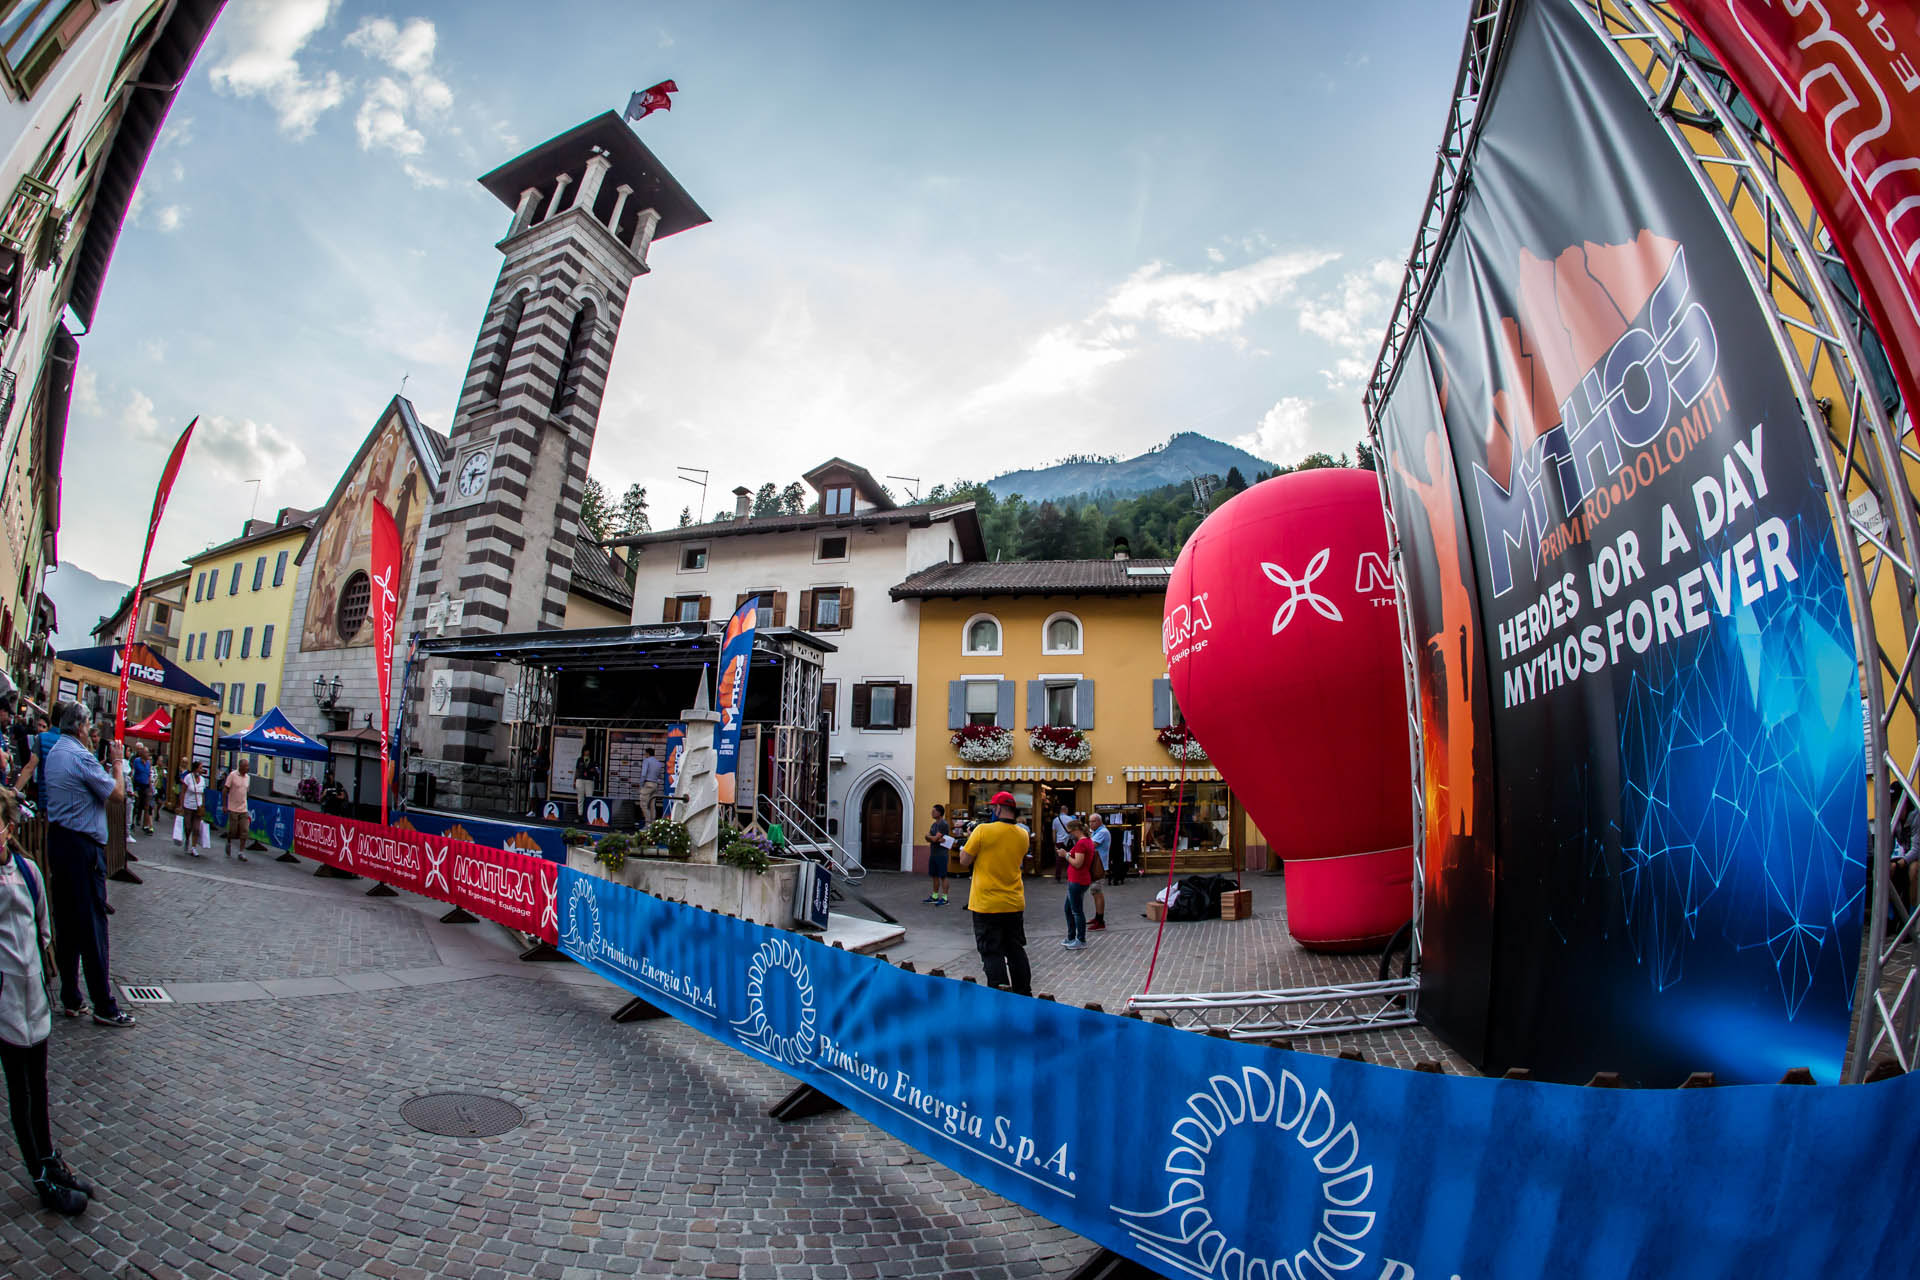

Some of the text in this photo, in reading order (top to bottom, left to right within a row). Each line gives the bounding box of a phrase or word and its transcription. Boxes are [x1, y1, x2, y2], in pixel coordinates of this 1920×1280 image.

[1472, 244, 1718, 598] MYTHOS
[1498, 573, 1580, 661] HEROES
[1660, 503, 1692, 566] A
[1692, 423, 1769, 541] DAY
[722, 654, 744, 731] MYTHOS
[358, 833, 420, 870] MONTURA
[454, 855, 535, 905] MONTURA
[468, 889, 497, 906] Ergonomic
[499, 901, 531, 917] Equipage
[601, 938, 717, 1009] Primiero Energia S.p.A.
[819, 1034, 1076, 1181] Primiero Energia S.p.A.
